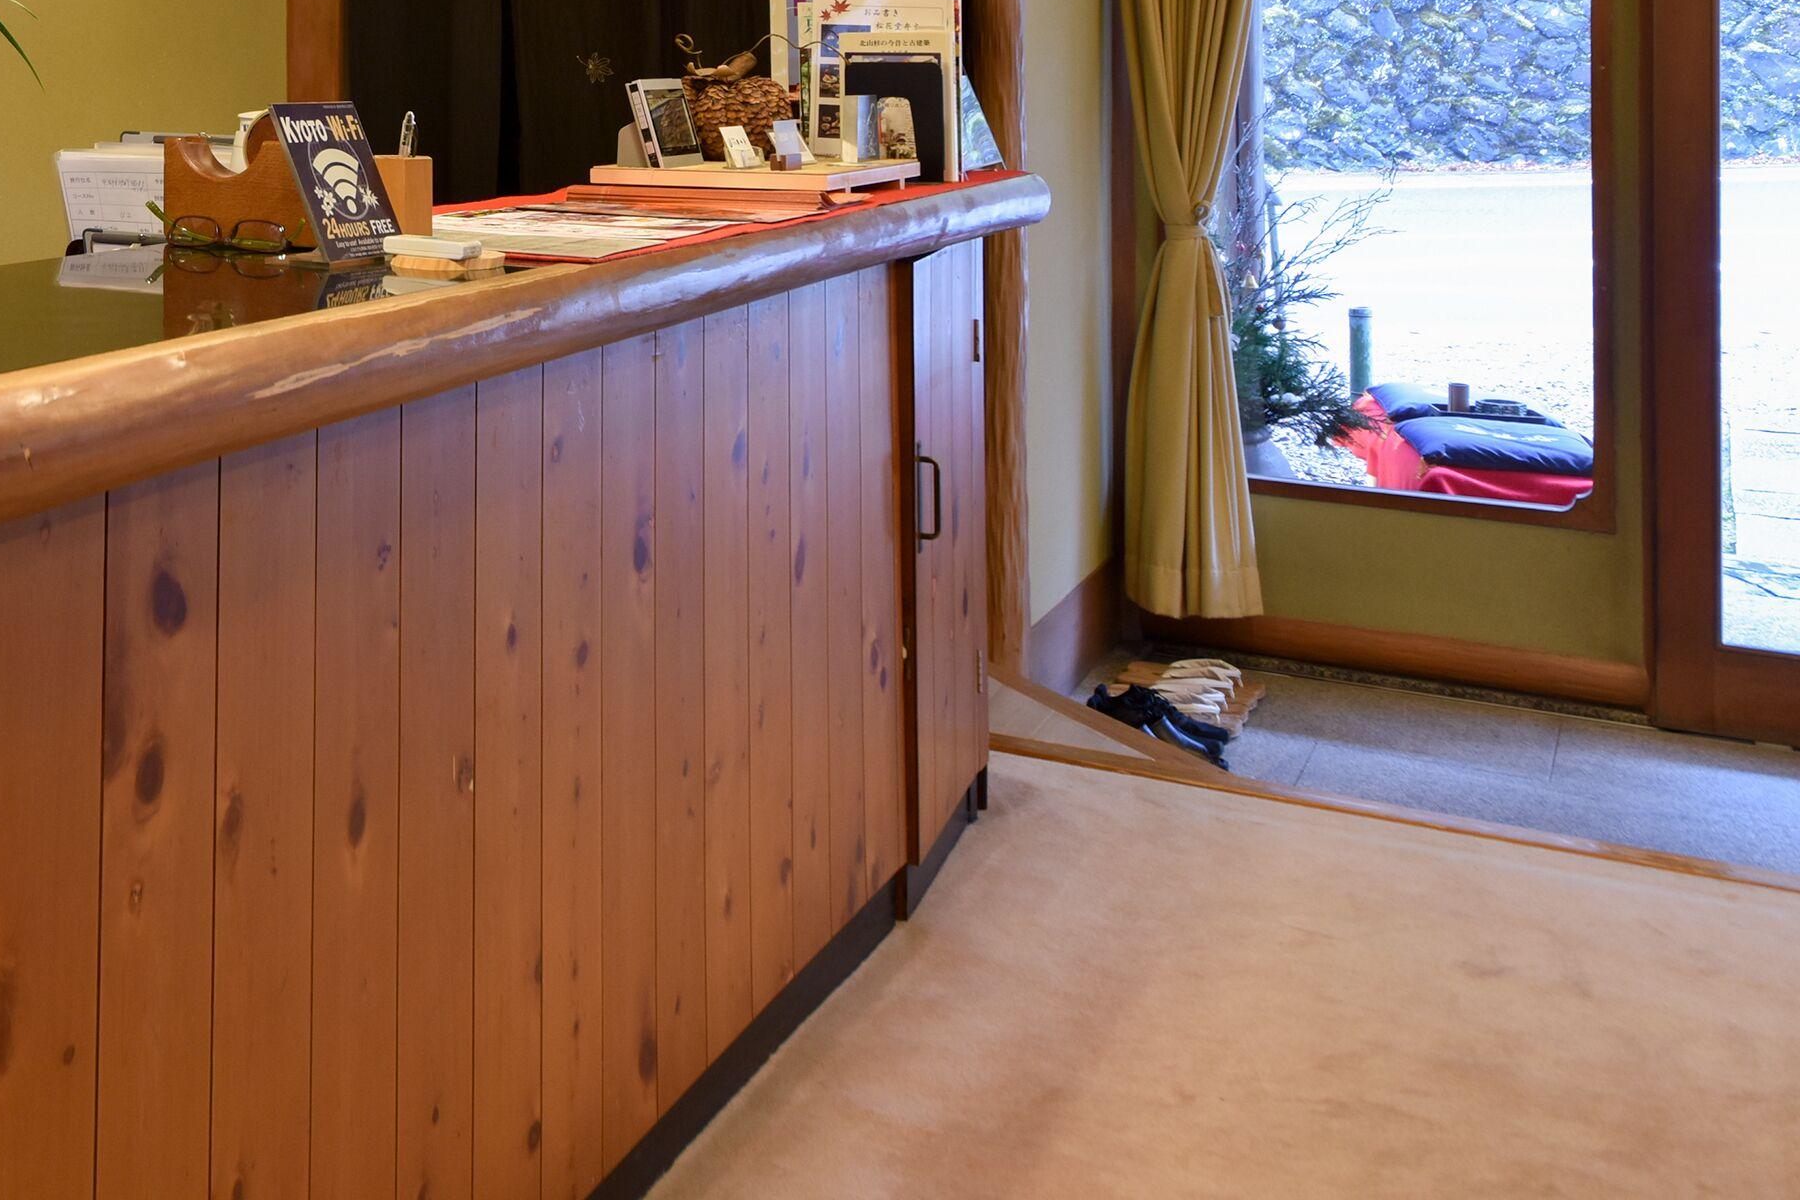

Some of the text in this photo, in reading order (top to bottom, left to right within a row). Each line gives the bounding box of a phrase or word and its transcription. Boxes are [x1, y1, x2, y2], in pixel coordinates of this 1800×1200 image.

[279, 115, 364, 144] KYOTO Wi-Fi
[370, 219, 395, 235] FREE
